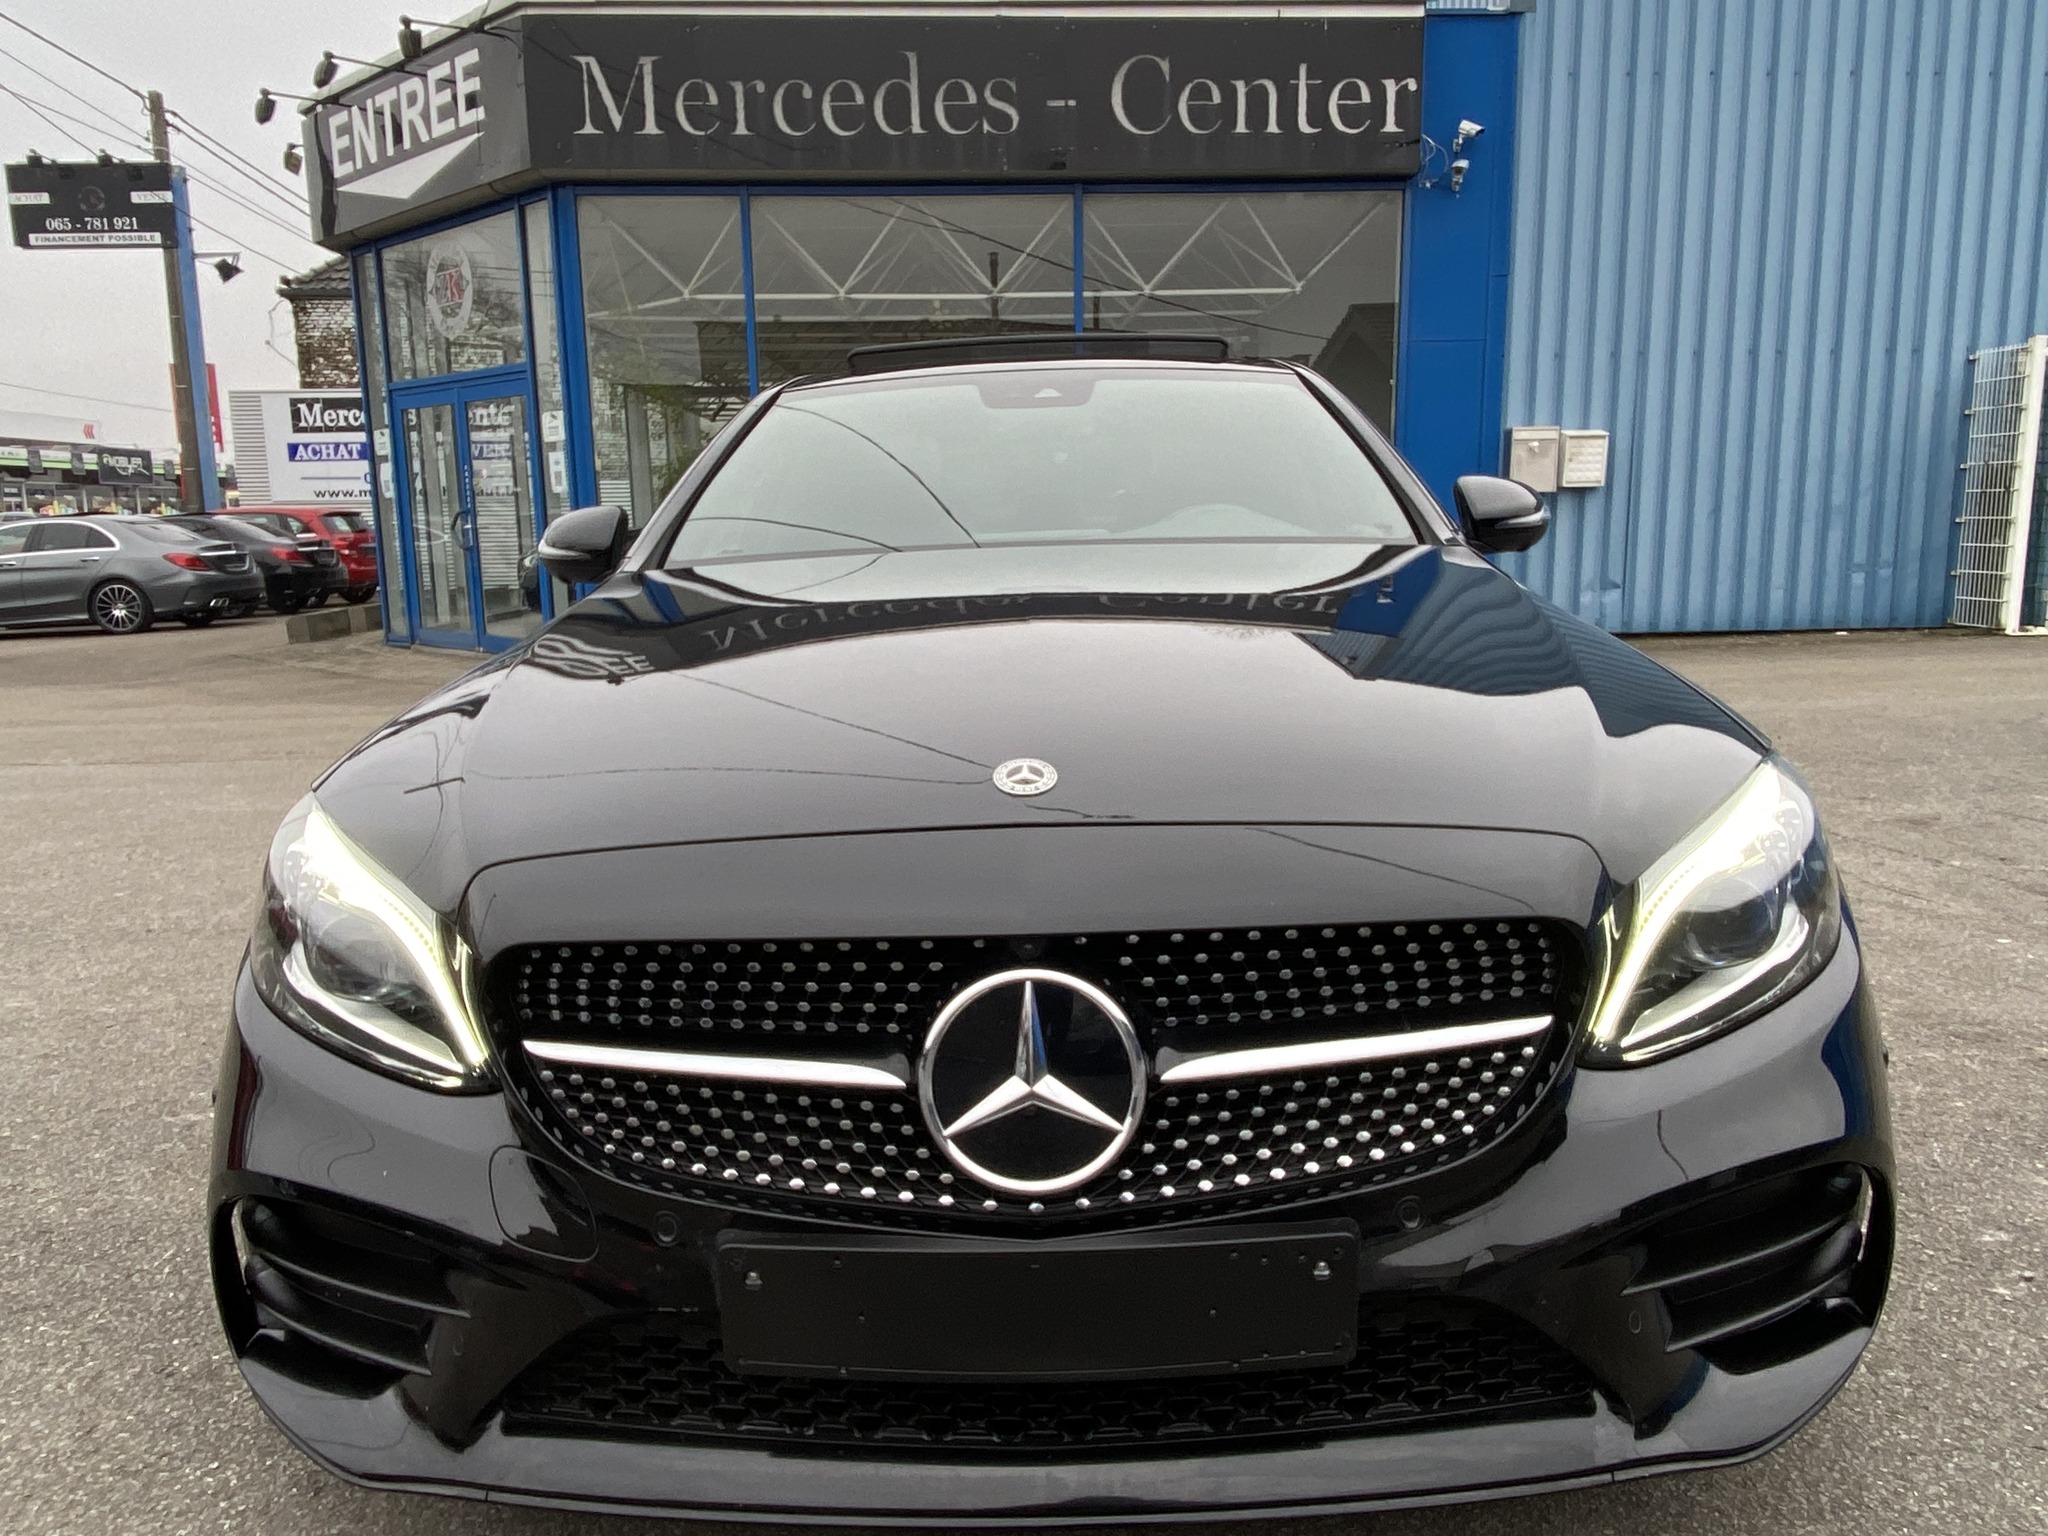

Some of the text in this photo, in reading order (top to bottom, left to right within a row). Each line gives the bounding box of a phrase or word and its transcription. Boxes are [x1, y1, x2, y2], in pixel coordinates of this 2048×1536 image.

[570, 51, 1020, 136] Mercedes
[1110, 54, 1418, 135] Center
[328, 48, 486, 178] ENTREE
[45, 217, 72, 231] 065
[84, 217, 109, 231] 781
[113, 216, 139, 230] 921
[34, 233, 156, 244] FINANCEMENT POSSIBLE
[294, 443, 361, 461] ACHAT
